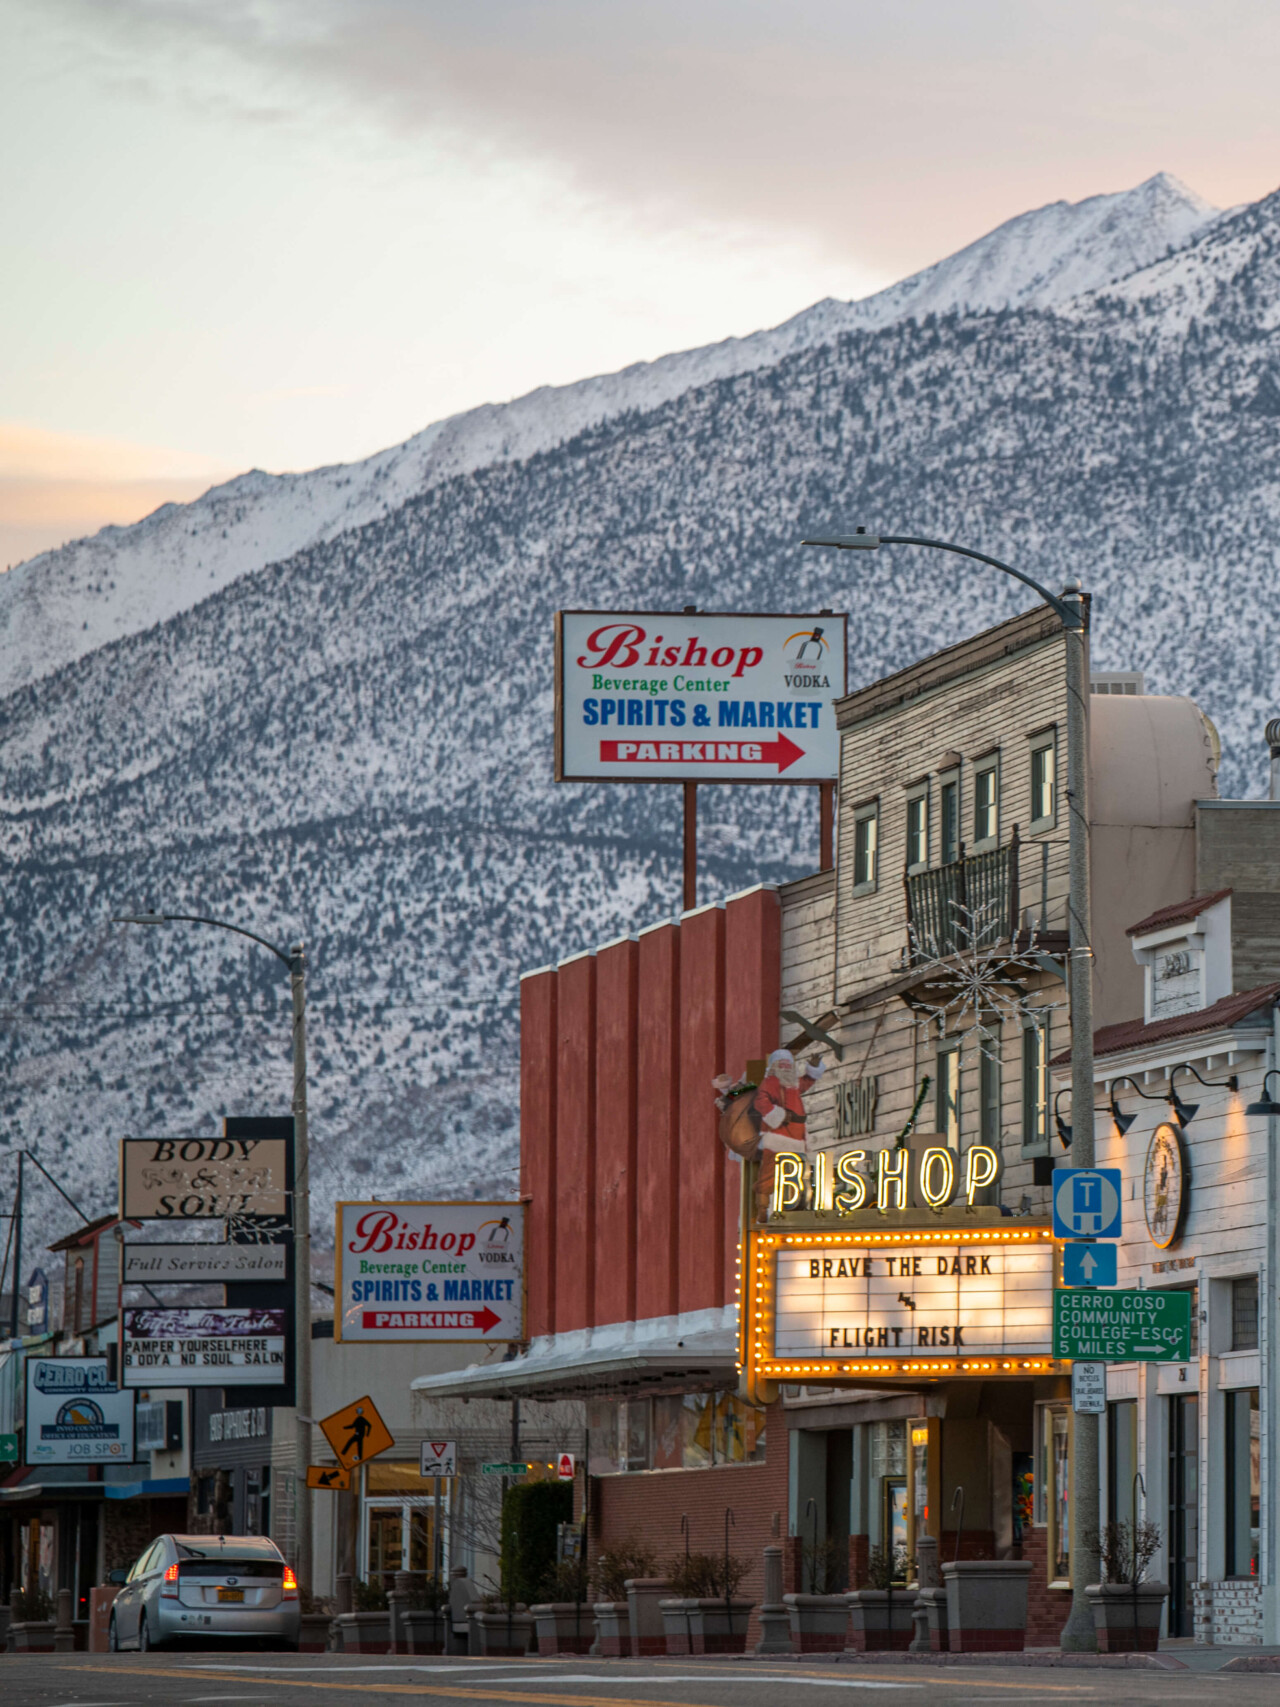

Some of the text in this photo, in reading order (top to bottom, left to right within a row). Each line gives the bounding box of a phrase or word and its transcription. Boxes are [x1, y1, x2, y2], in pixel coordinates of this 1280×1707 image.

[576, 623, 764, 678] Bishop
[592, 674, 730, 696] Beverage Center
[784, 675, 831, 688] VODKA
[583, 698, 823, 728] SPIRITS & MARKET
[617, 743, 763, 761] PARKING
[151, 1140, 261, 1162] BODY
[191, 1168, 217, 1189] &
[772, 1145, 1002, 1214] BISHOP
[155, 1195, 257, 1217] SOUL
[349, 1210, 476, 1257] Bishop
[127, 1256, 284, 1271] Full Service Salon
[478, 1252, 515, 1263] VODKA
[810, 1255, 992, 1278] BRAVE THE DARK
[360, 1260, 467, 1278] Beverage Center
[352, 1279, 514, 1302] SPIRITS & MARKET
[1060, 1295, 1166, 1310] CERRO COSO
[375, 1313, 475, 1327] PARKING
[1060, 1310, 1157, 1325] COMMUNITY
[830, 1325, 966, 1348] FLIGHT RISK
[124, 1340, 174, 1353] PAMPER
[1059, 1341, 1126, 1355] 5 MILES
[203, 1352, 233, 1364] SOUL
[244, 1352, 284, 1364] SALON
[34, 1362, 117, 1386] CERRO CO
[1083, 1366, 1095, 1375] NO
[67, 1443, 91, 1455] JOB
